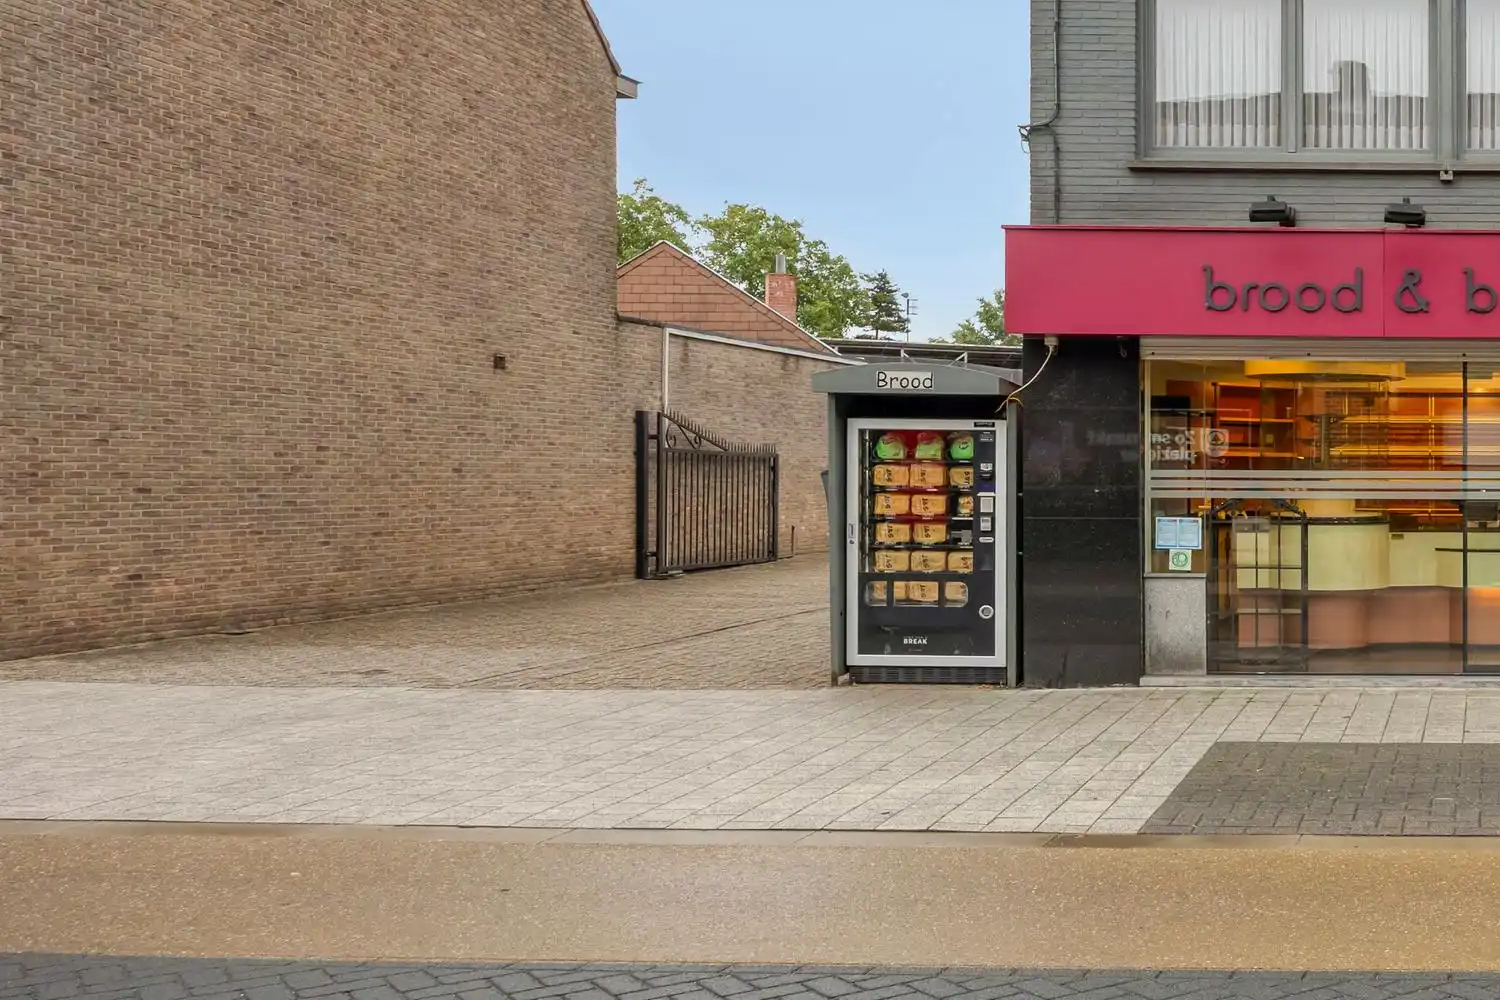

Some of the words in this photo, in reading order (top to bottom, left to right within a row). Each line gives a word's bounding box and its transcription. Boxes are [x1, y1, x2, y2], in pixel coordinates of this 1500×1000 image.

[1203, 264, 1364, 313] brood
[1394, 268, 1430, 314] &
[877, 371, 934, 389] Brood
